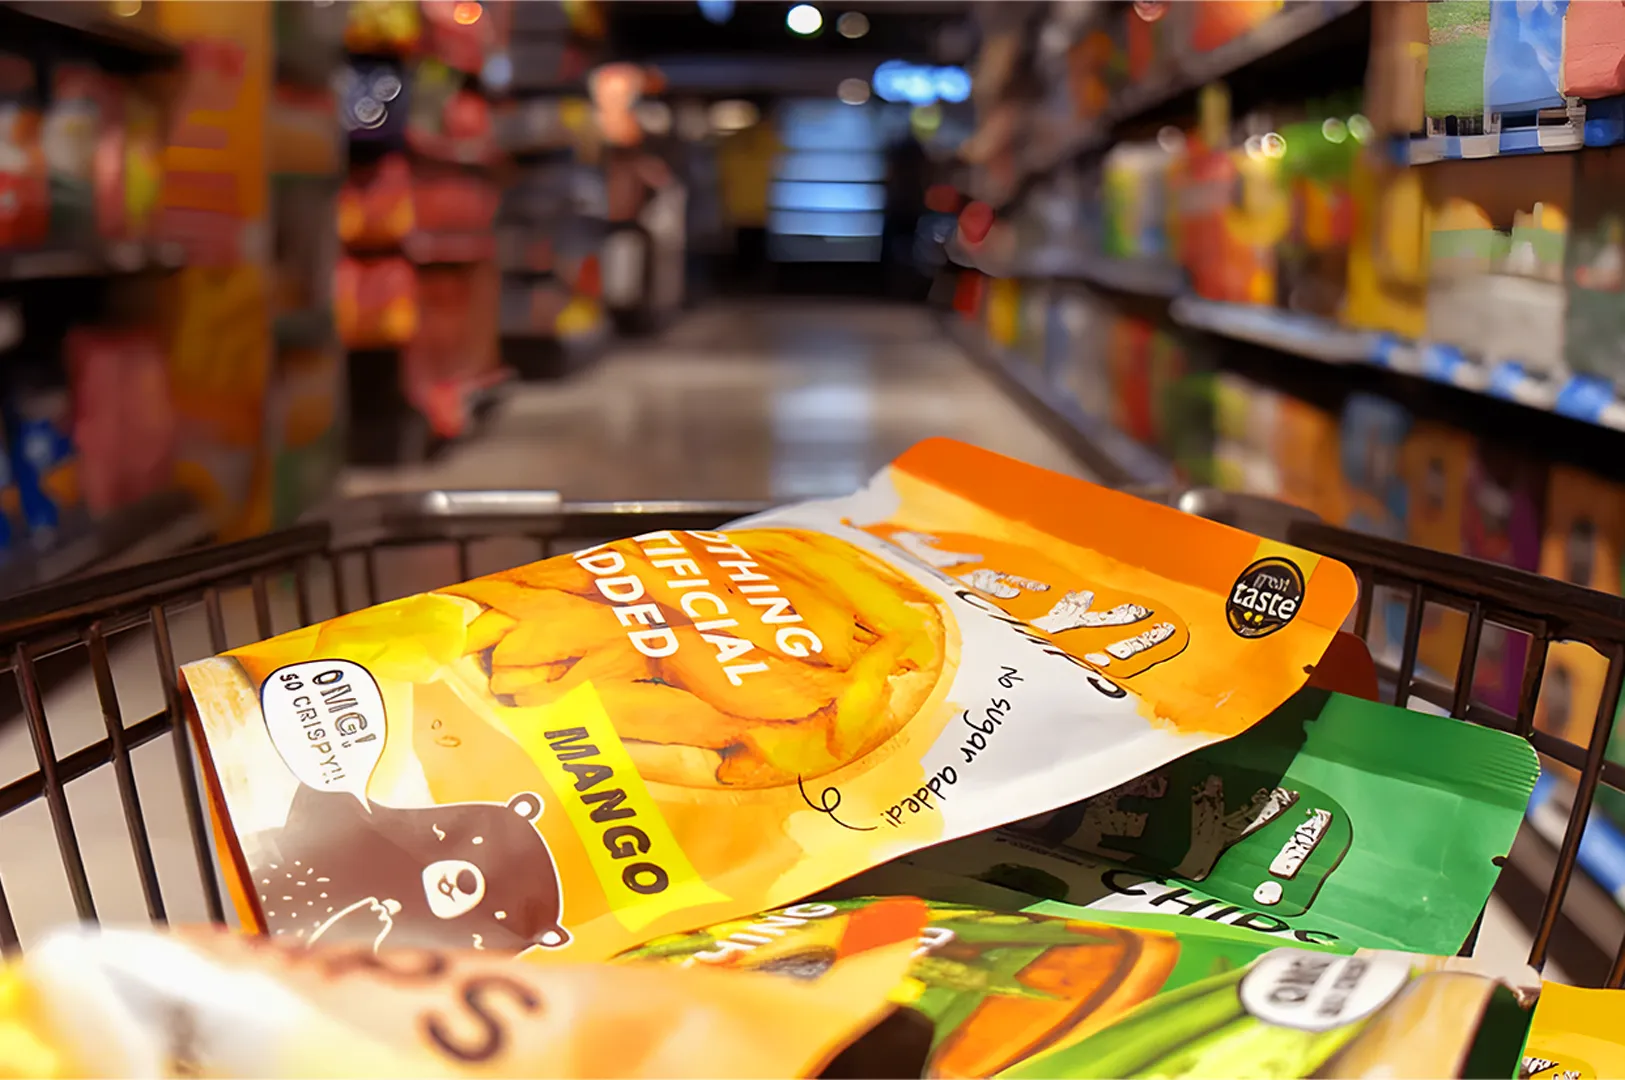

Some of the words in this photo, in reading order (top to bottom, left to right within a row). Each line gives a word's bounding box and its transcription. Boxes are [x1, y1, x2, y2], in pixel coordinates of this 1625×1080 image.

[1233, 580, 1300, 620] taste
[312, 669, 377, 748] OMG!
[998, 665, 1024, 688] No
[293, 695, 346, 784] CRISPY!!
[960, 698, 1012, 764] sugar
[543, 726, 670, 895] MANGO
[879, 765, 958, 829] added!
